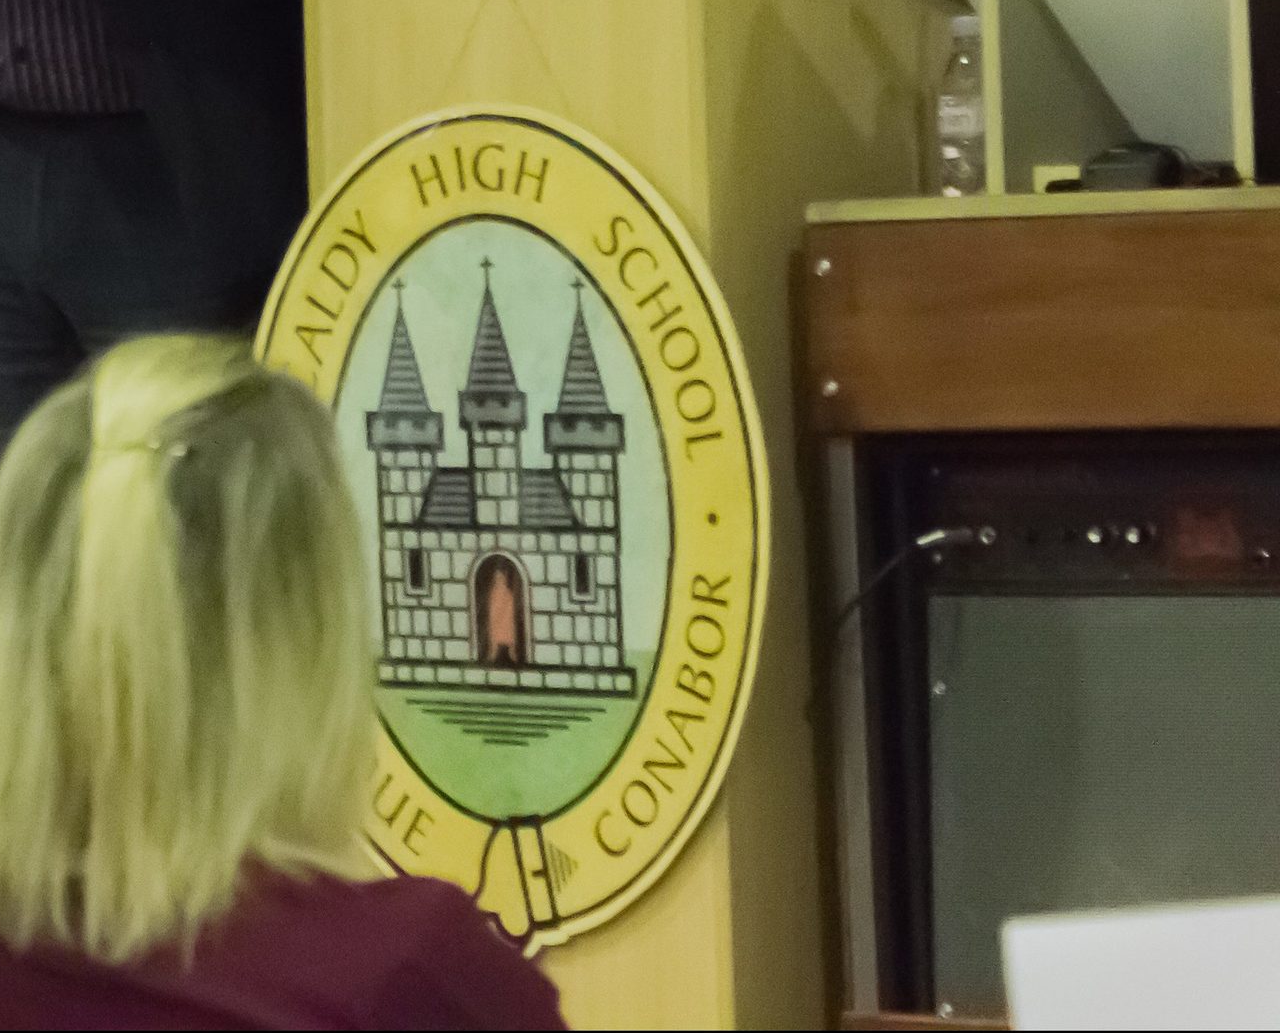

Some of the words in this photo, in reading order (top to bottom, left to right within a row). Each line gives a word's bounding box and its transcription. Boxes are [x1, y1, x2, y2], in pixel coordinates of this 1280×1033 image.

[410, 142, 550, 208] HIGH
[594, 214, 725, 462] SCHOOL
[596, 574, 733, 858] CONABOR
